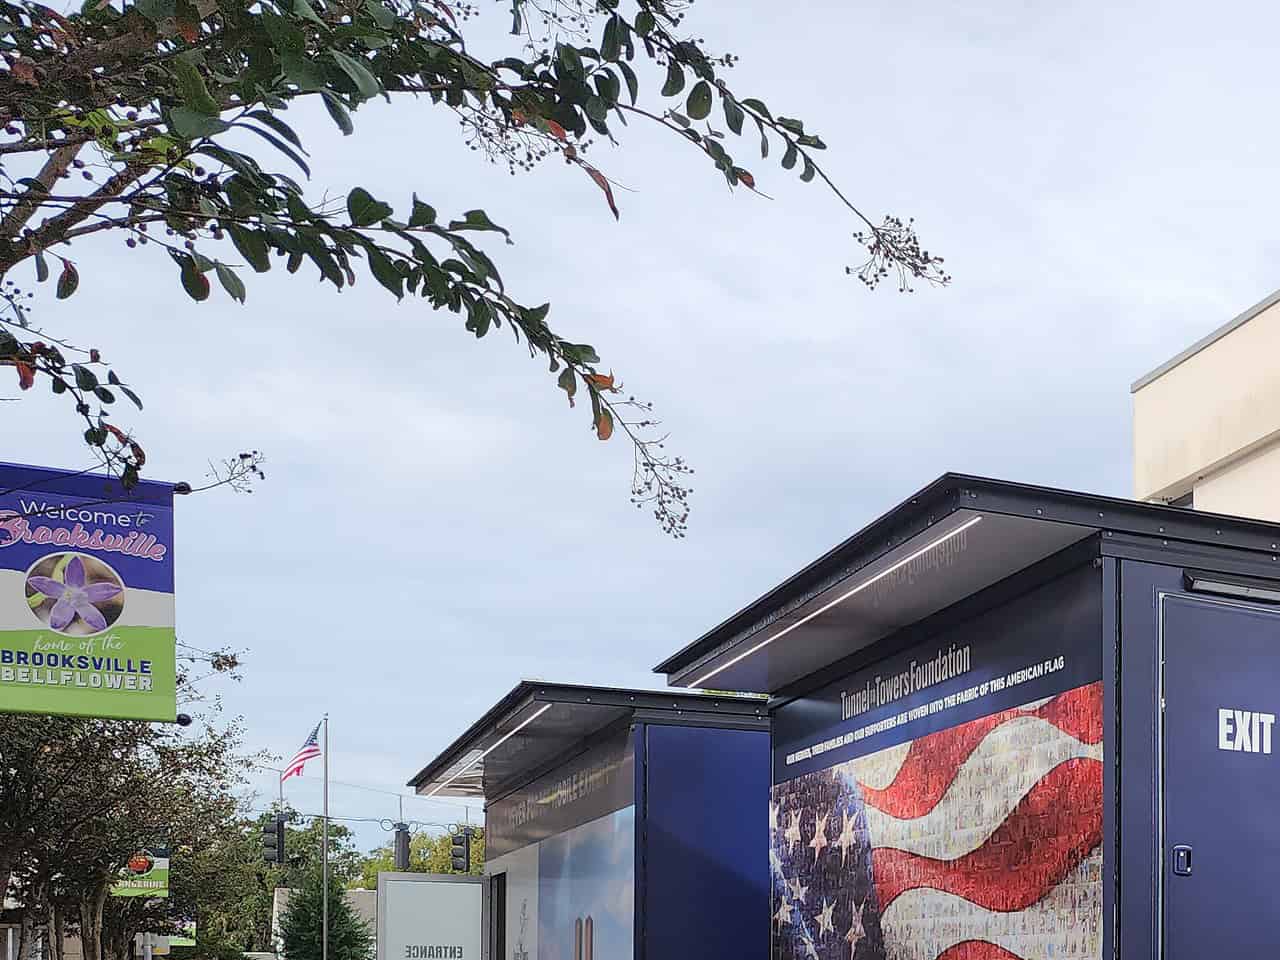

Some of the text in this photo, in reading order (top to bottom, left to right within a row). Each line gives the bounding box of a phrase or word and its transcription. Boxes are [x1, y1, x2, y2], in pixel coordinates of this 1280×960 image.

[20, 499, 155, 527] Welcome to
[33, 634, 126, 655] home of the
[1, 649, 152, 675] BROOKSVILLE
[1, 666, 153, 692] BELLFLOWER
[841, 681, 870, 720] Tunnel
[875, 670, 910, 708] Towers
[910, 643, 971, 693] Foundation
[896, 711, 908, 725] ARE
[908, 703, 929, 721] WOVEN
[929, 700, 944, 715] INTO
[944, 695, 956, 709] THE
[956, 687, 979, 706] FABRIC
[979, 683, 990, 699] OF
[989, 678, 1007, 695] THIS
[1006, 663, 1044, 690] AMERICAN
[1044, 656, 1065, 676] FLAG
[1218, 708, 1275, 754] EXIT
